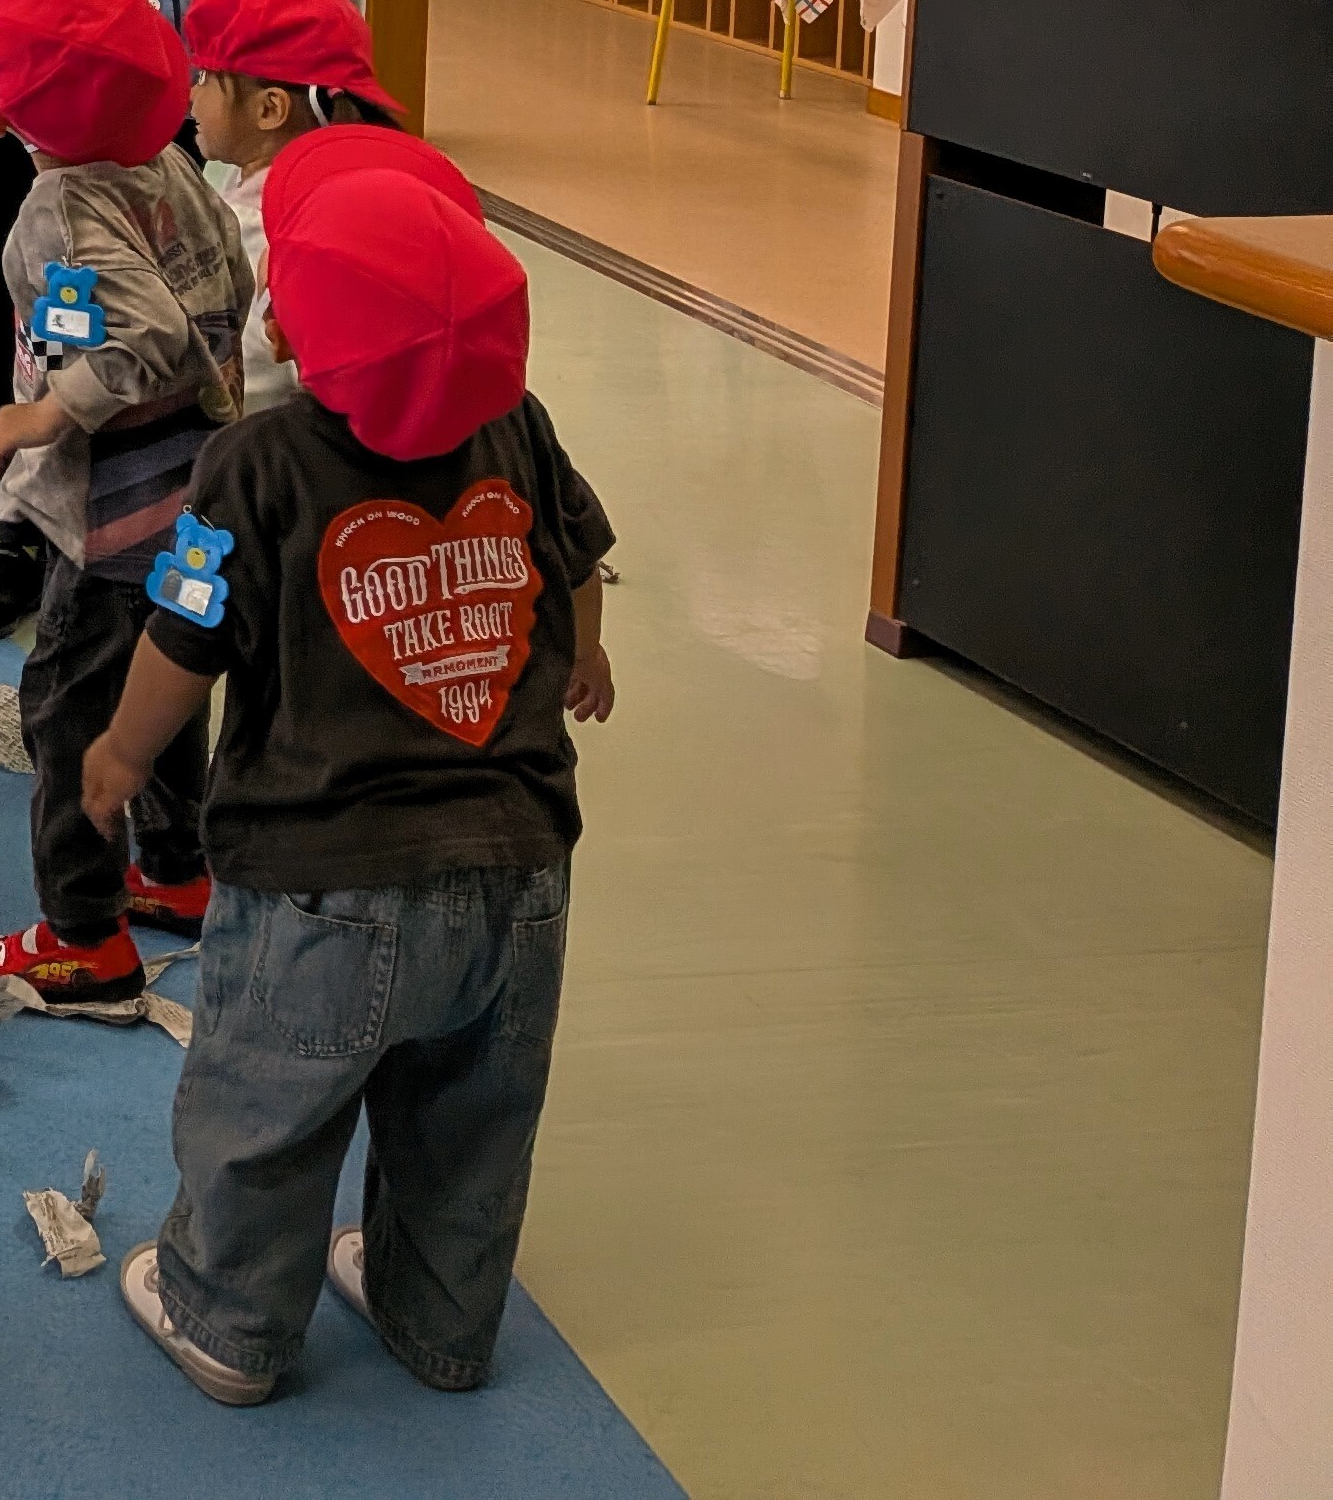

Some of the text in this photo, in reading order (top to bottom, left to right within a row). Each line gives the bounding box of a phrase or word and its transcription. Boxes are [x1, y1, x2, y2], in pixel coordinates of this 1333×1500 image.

[335, 510, 420, 548] KNOCK ON WOOD
[340, 536, 529, 624] GOOD THINGS
[383, 601, 514, 661] TAKE ROOT
[438, 678, 493, 724] 1994
